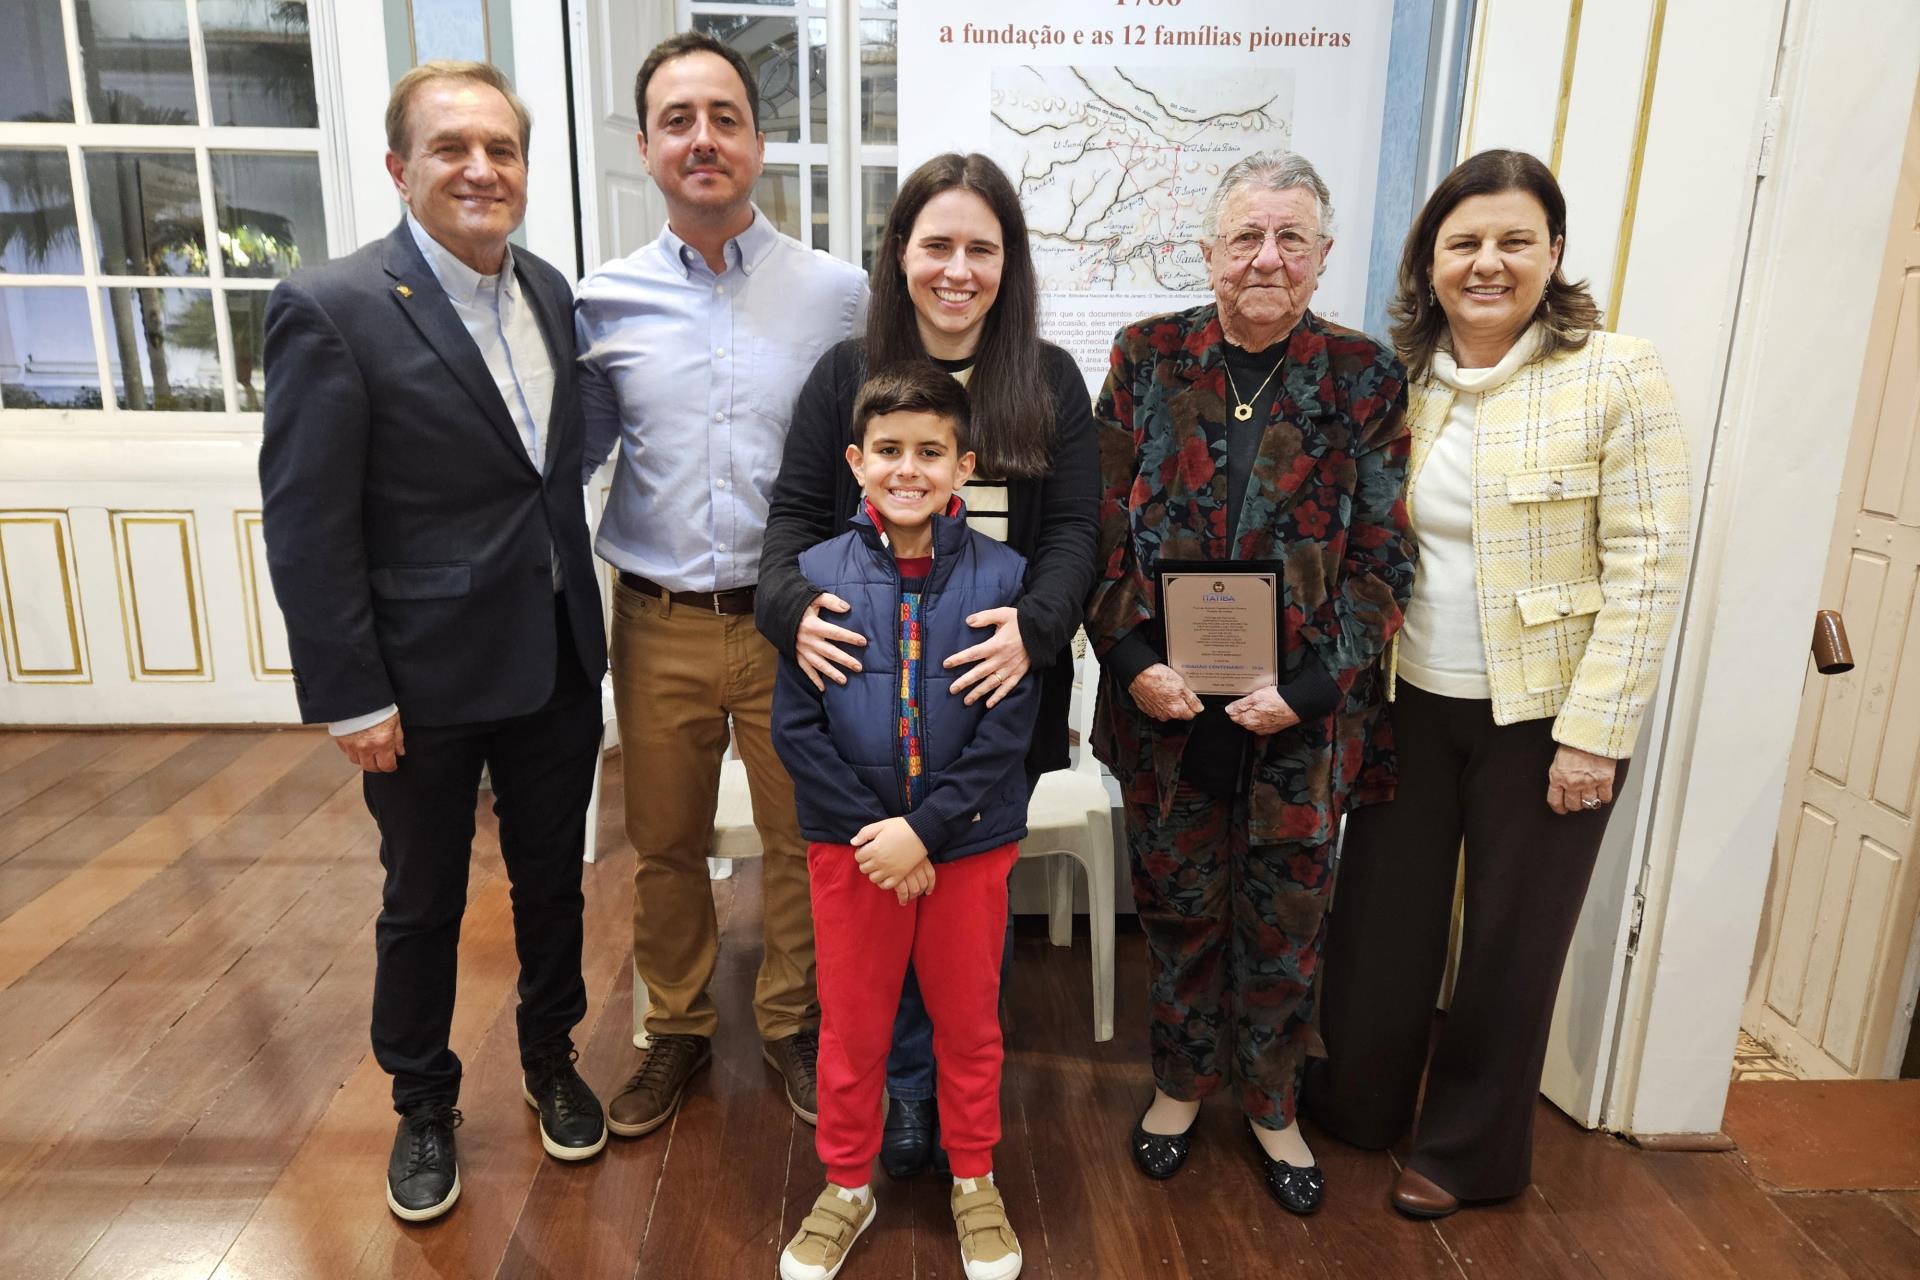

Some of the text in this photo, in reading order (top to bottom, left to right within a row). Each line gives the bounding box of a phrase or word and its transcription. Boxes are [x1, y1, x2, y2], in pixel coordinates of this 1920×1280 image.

[939, 23, 1351, 52] a fundação e as 12 famílias pioneiras
[1060, 311, 1074, 320] que
[1088, 310, 1132, 318] documentos
[1090, 319, 1106, 327] eles
[1049, 328, 1113, 338] povoação ganhou
[1072, 337, 1109, 345] conhecida
